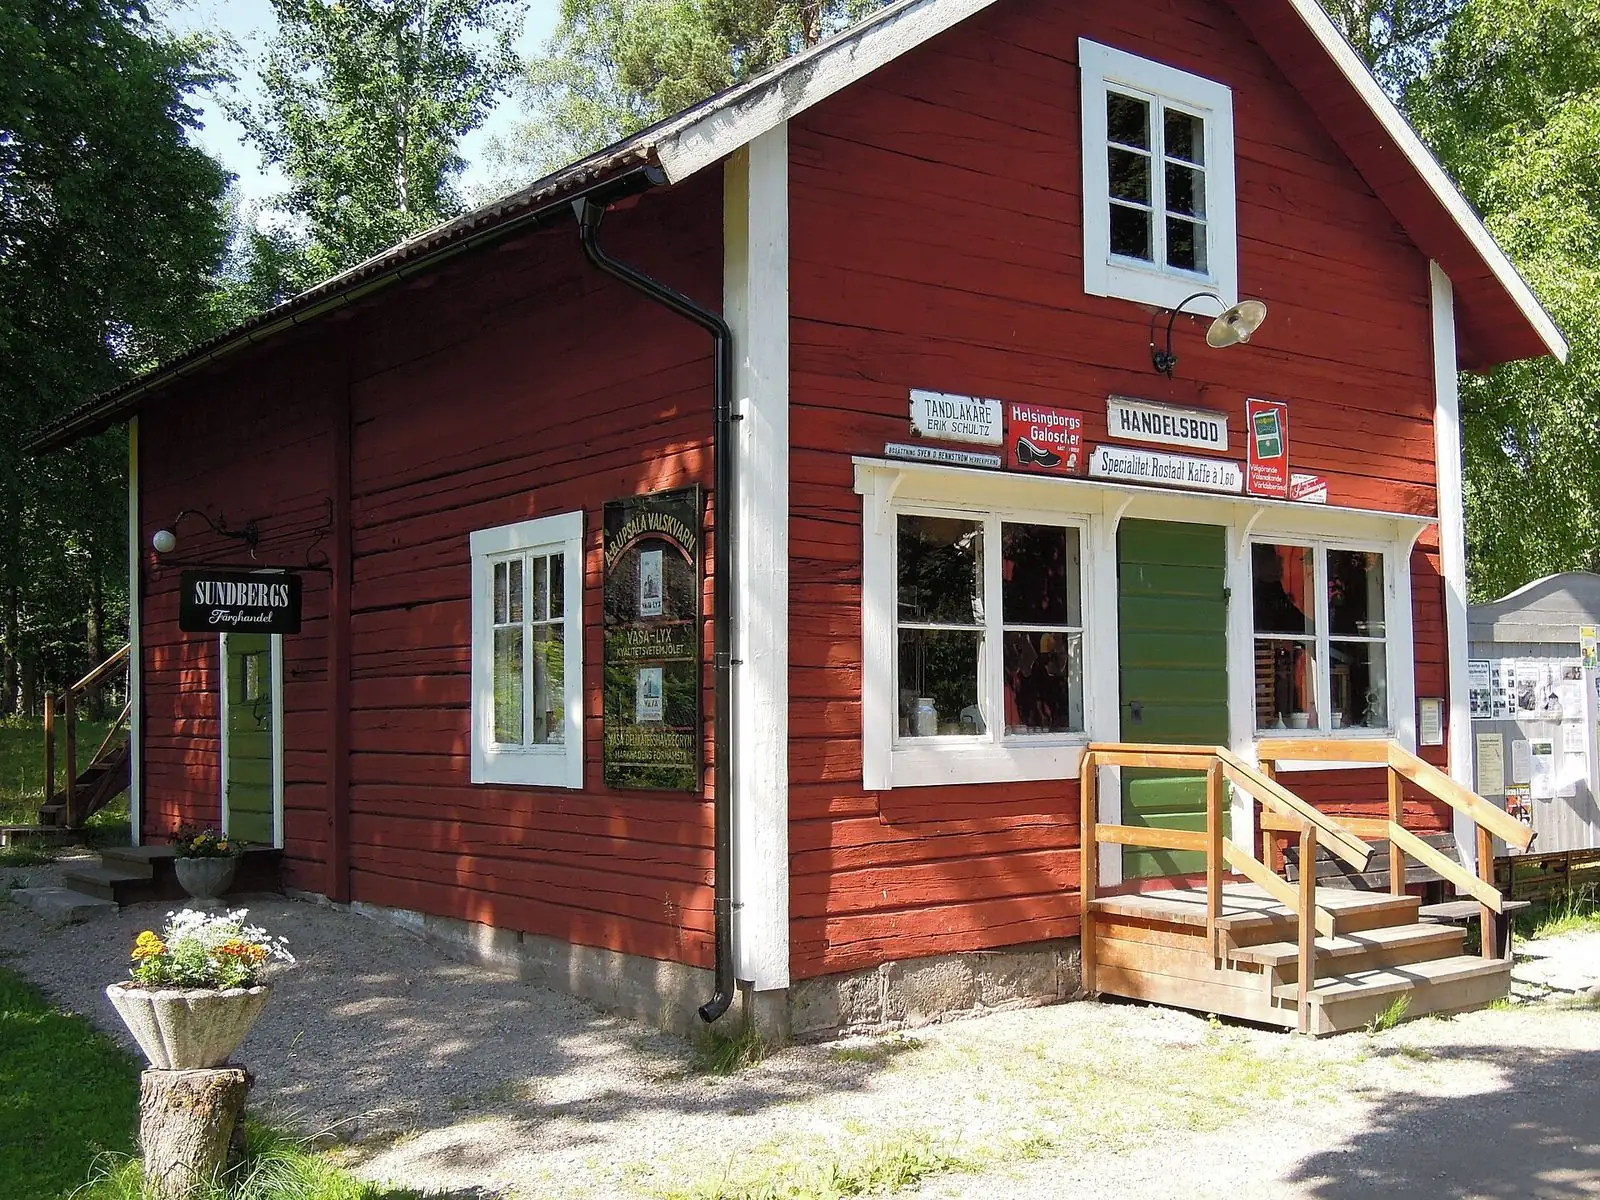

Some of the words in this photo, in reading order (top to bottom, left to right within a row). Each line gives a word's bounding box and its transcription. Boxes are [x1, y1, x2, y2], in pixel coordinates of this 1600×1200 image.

[925, 399, 992, 424] TANDLÄKARE
[1012, 406, 1080, 430] Helsingborgs
[927, 419, 947, 431] ERIK
[951, 421, 990, 436] SCHULTZ
[1031, 425, 1080, 445] Galoscher
[1119, 409, 1218, 442] HANDELSBOD
[917, 449, 931, 458] SVEN
[1101, 451, 1151, 476] Specialitet:
[1188, 461, 1210, 483] Kaffe
[1212, 467, 1217, 483] à
[1220, 466, 1235, 486] 1,60
[616, 514, 647, 548] UPSALA
[648, 512, 696, 552] VALSKVARN
[195, 580, 289, 607] SUNDBERGS
[208, 608, 274, 625] Färghandel
